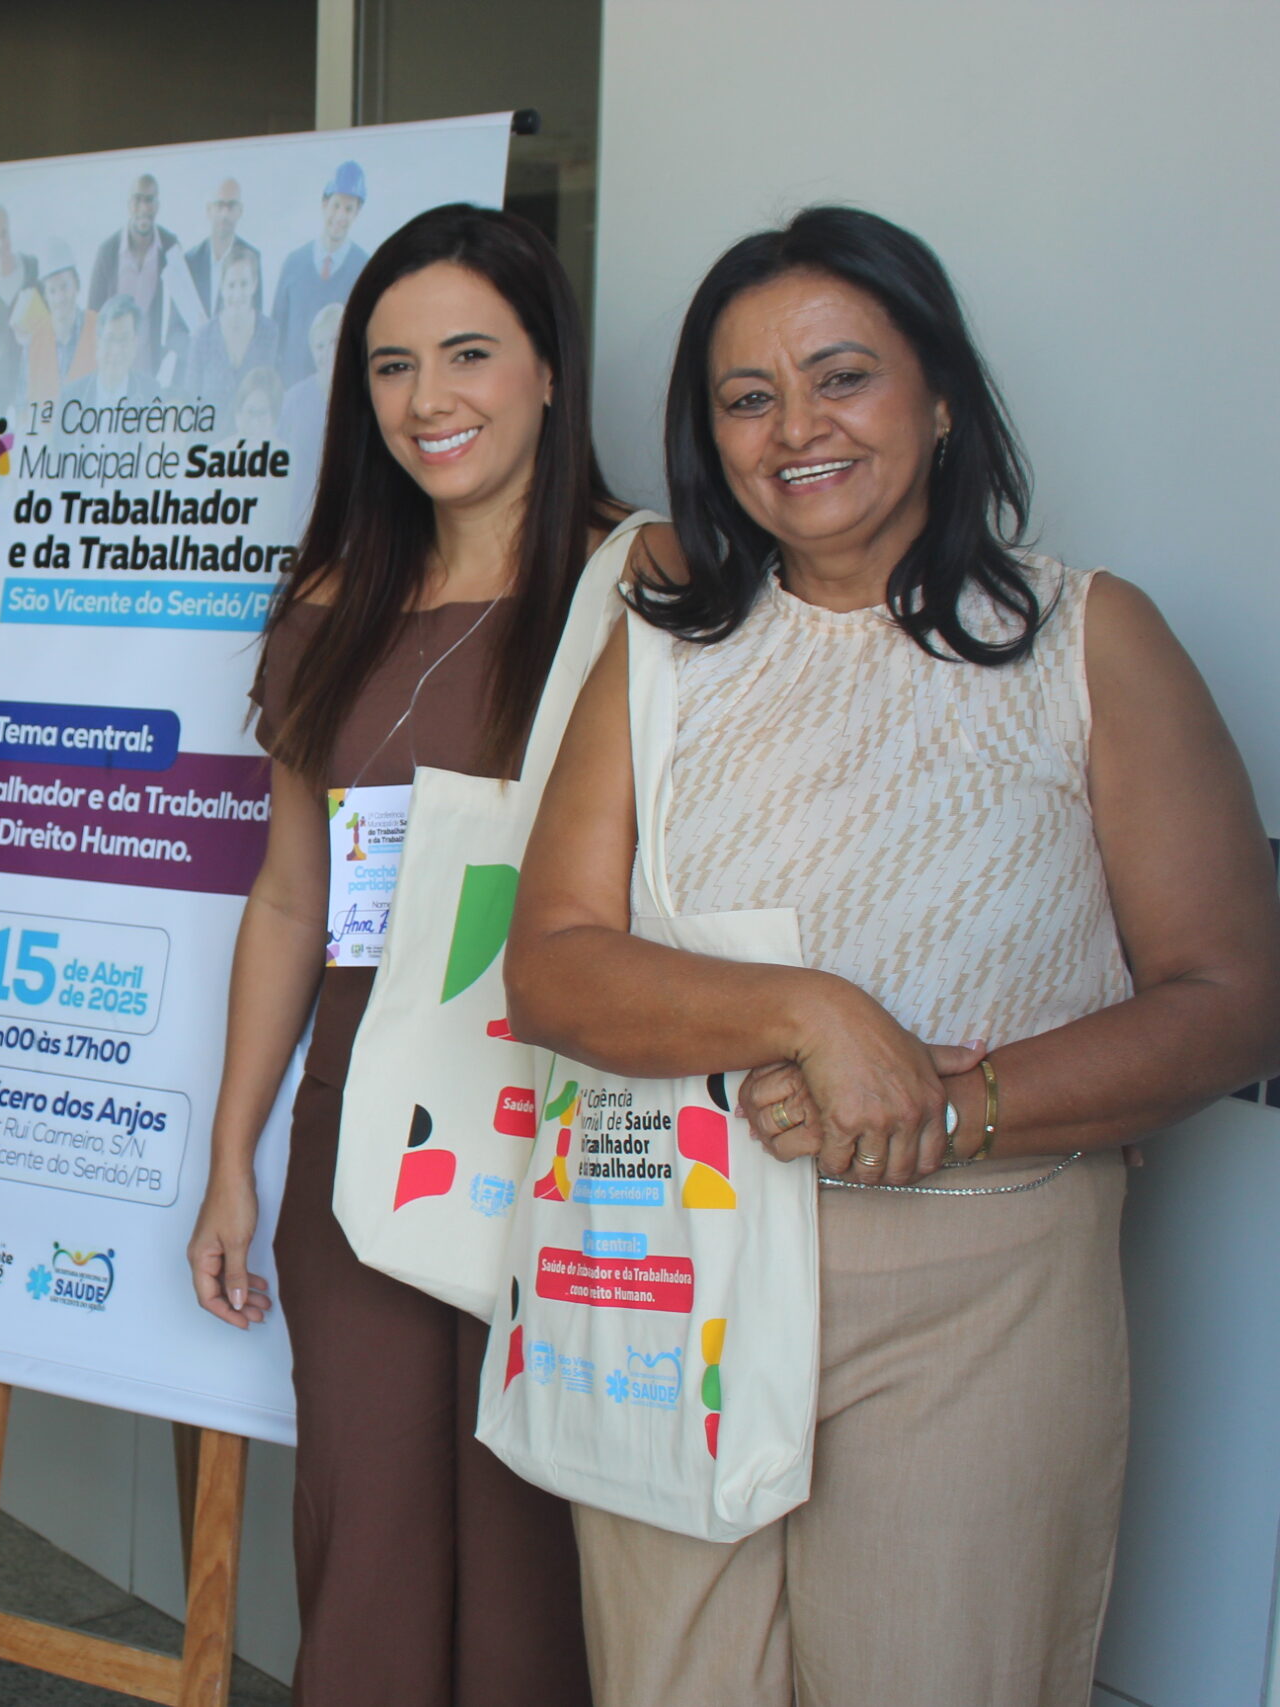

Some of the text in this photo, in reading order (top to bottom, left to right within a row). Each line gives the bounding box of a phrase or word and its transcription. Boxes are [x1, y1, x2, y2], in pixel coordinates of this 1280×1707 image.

[25, 396, 216, 436] 1ª Conferência
[19, 440, 291, 488] Municipal de Saúde
[14, 489, 258, 526] do Trabalhador
[8, 534, 300, 575] e da Trabalhadora
[8, 586, 273, 620] São Vicente do Seridó/P
[61, 725, 154, 753] central:
[87, 790, 105, 810] e
[108, 785, 140, 813] da
[80, 826, 193, 863] Humano.
[381, 835, 404, 843] Trabal
[63, 958, 89, 983] de
[91, 962, 144, 989] Abril
[58, 984, 149, 1017] de 2025
[36, 1031, 62, 1055] às
[64, 1034, 131, 1065] 17h00
[51, 1091, 94, 1121] dos
[96, 1097, 168, 1136] Anjos
[503, 1096, 535, 1114] Saúde
[587, 1087, 633, 1109] Coência
[606, 1110, 623, 1131] de
[624, 1109, 672, 1131] Saúde
[2, 1116, 31, 1139] Rui
[109, 1134, 147, 1160] S/N
[46, 1153, 70, 1176] do
[72, 1155, 162, 1192] Seridó/PB
[541, 1258, 566, 1275] Saúde
[615, 1269, 621, 1280] e
[623, 1267, 633, 1281] da
[633, 1268, 692, 1285] Trabalhadora
[54, 1278, 106, 1304] SAÚDE
[614, 1286, 656, 1303] Humano.
